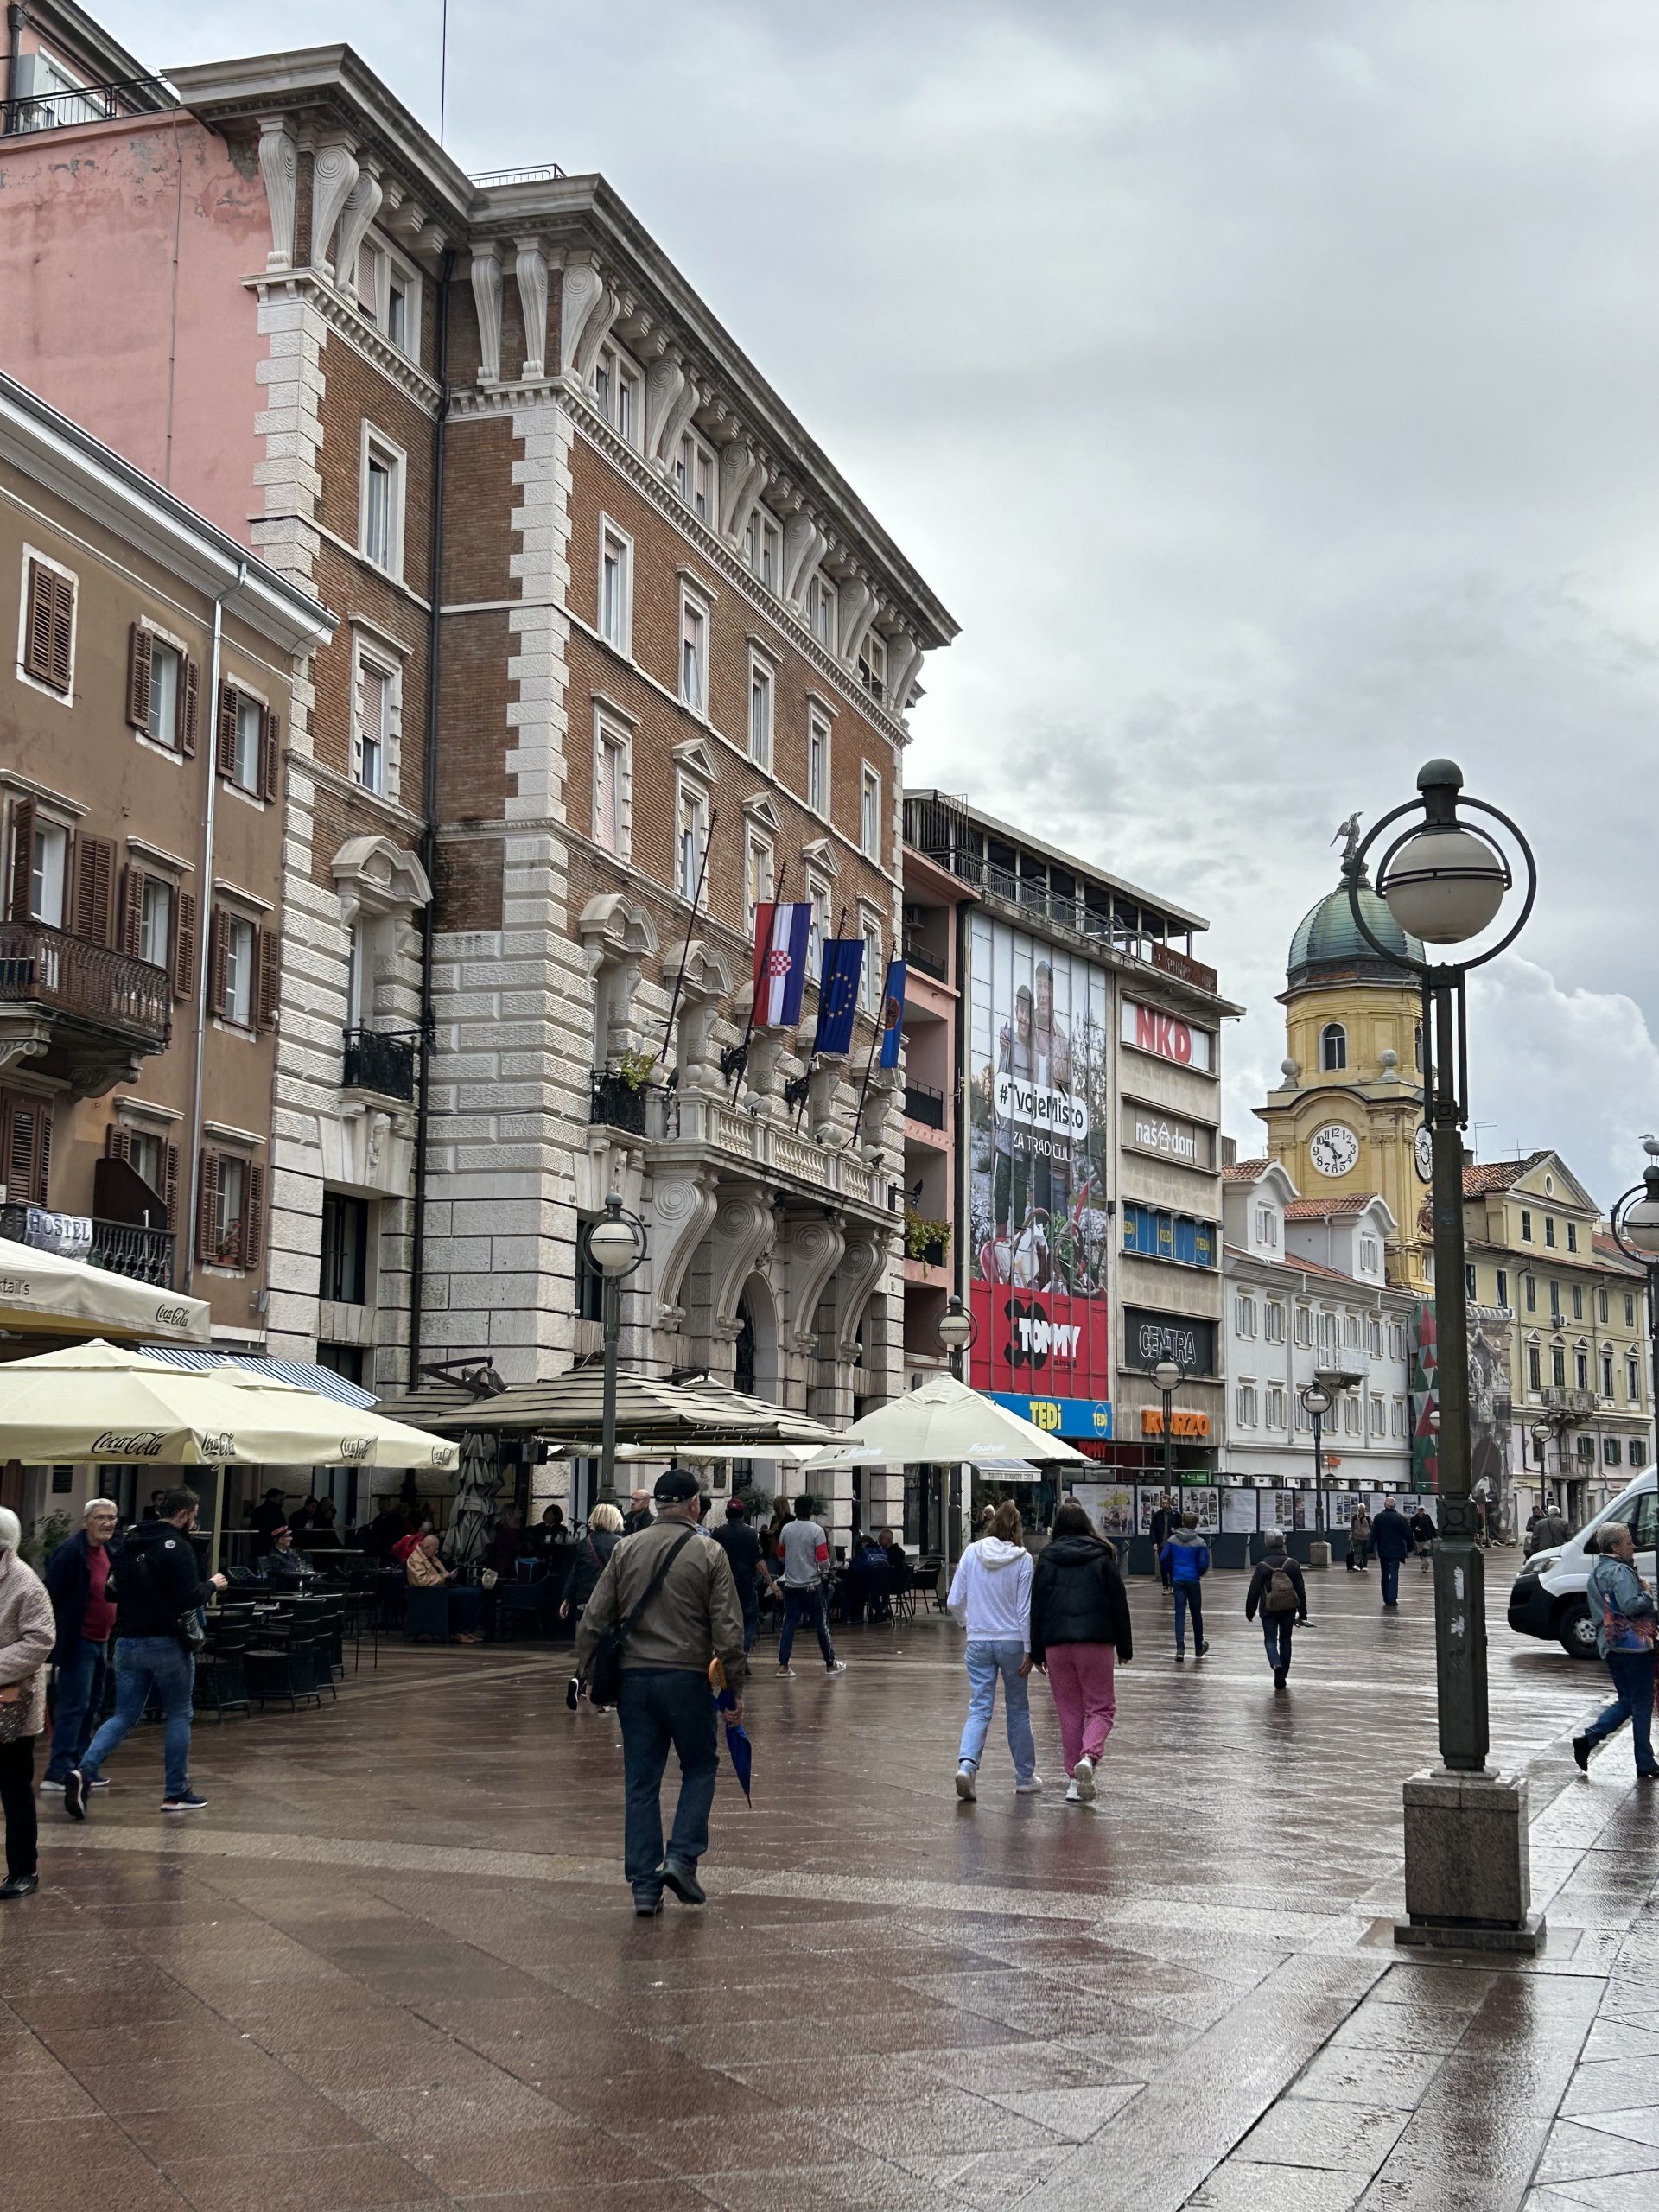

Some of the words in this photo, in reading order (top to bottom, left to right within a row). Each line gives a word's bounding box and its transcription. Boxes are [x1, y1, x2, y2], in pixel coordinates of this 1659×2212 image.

[1136, 1002, 1192, 1065] NKD
[999, 1082, 1084, 1128] #TvojeMisto
[1135, 1120, 1158, 1147] naš
[1171, 1127, 1197, 1160] dom
[1332, 1128, 1340, 1137] 12
[1346, 1134, 1352, 1144] 2
[1027, 1135, 1074, 1162] TRADCIJU
[1313, 1147, 1319, 1156] 9
[1317, 1156, 1323, 1166] 8
[1350, 1144, 1357, 1154] 3
[1325, 1162, 1331, 1173] 7
[1339, 1160, 1346, 1172] 5
[29, 1213, 91, 1242] HOSTEL
[1019, 1317, 1082, 1358] TOMMY
[1139, 1324, 1196, 1364] CENTRA
[1029, 1401, 1062, 1430] TEDi
[1092, 1413, 1108, 1427] TEDi
[1141, 1409, 1210, 1437] KORZO
